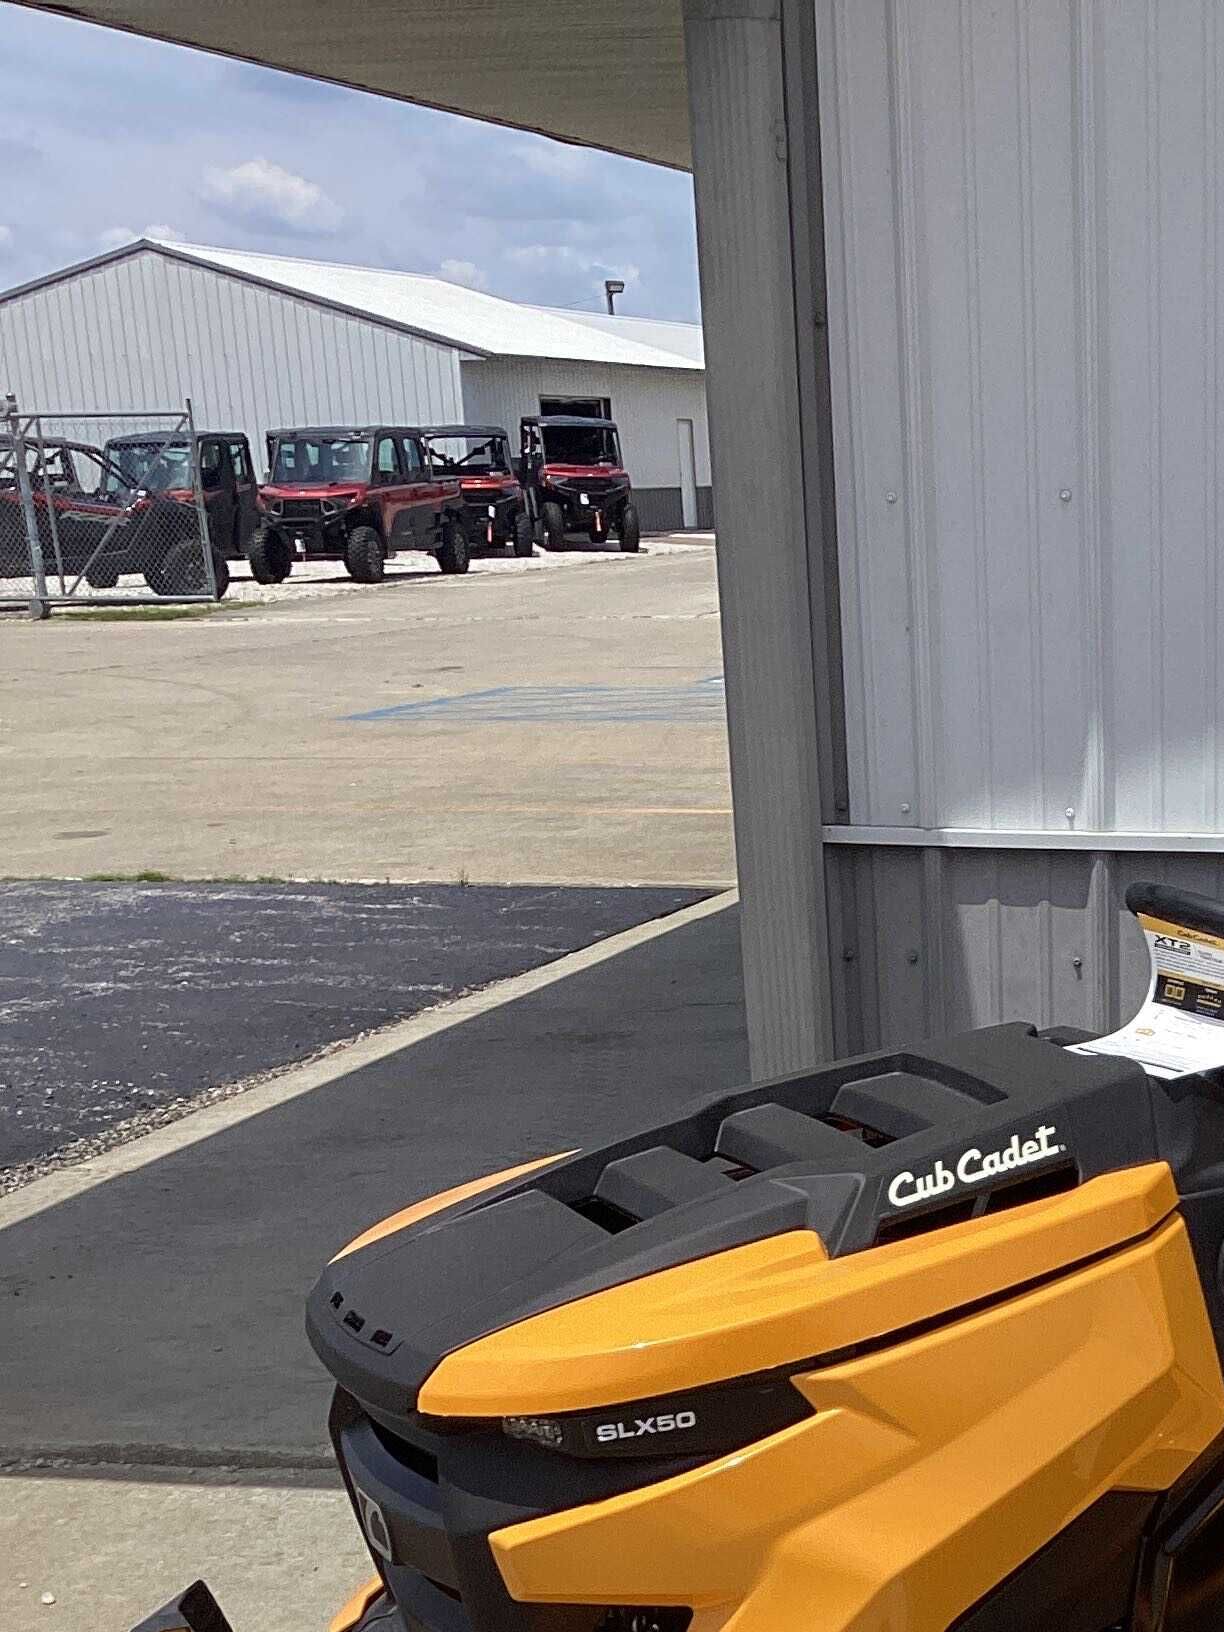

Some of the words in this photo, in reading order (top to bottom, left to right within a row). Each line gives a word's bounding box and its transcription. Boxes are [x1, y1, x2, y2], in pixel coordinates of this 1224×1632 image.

[887, 1161, 955, 1207] Cub
[956, 1125, 1061, 1184] Cadet
[596, 1411, 696, 1442] SLX50
